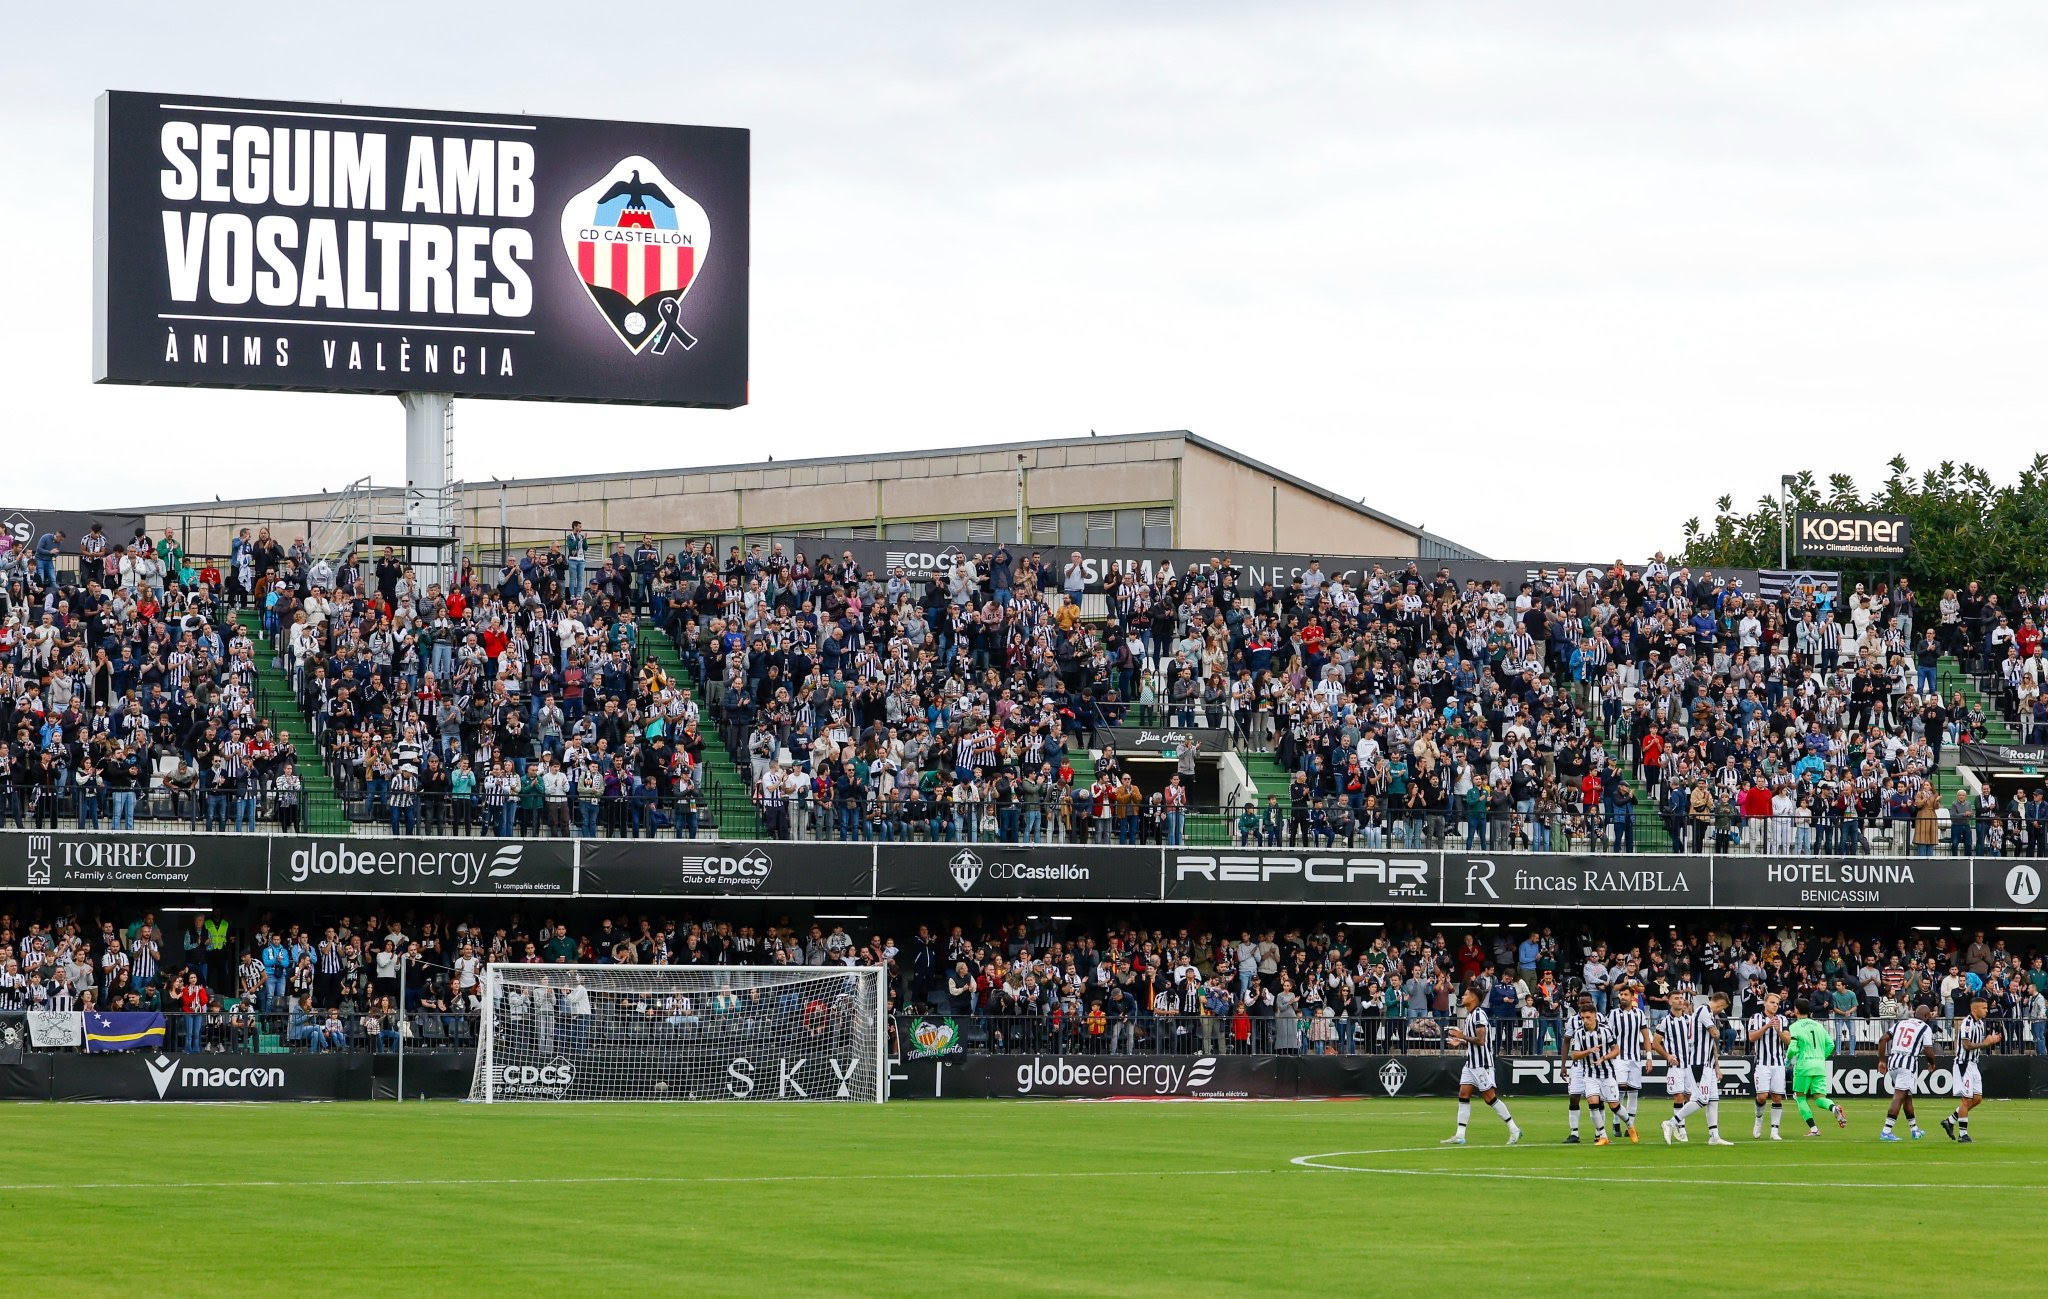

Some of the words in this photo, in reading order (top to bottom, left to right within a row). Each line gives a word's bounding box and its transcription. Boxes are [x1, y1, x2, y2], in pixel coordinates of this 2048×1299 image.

[160, 121, 387, 212] SEGUIM
[401, 136, 534, 217] AMB
[580, 229, 599, 241] CD
[604, 230, 692, 245] CASTELLÓN
[161, 210, 534, 317] VOSALTRES
[165, 327, 289, 367] ÀNIMS
[322, 338, 513, 376] VALÈNCIA
[1826, 543, 1873, 553] Climatización
[1873, 545, 1904, 554] eficiente
[1135, 731, 1161, 745] Blue
[2010, 749, 2045, 760] Rosell
[58, 842, 196, 868] TORRECID
[290, 843, 487, 886] globeenergy
[703, 856, 768, 876] CDCS
[1177, 856, 1428, 884] REPCAR
[1767, 864, 1837, 883] HOTEL
[1840, 865, 1915, 884] SUNNA
[65, 871, 72, 879] A
[74, 871, 105, 882] Family
[106, 872, 113, 880] &
[115, 871, 143, 880] Green
[144, 871, 189, 882] Company
[682, 876, 703, 884] Club
[704, 876, 716, 884] de
[717, 876, 760, 886] Empresas
[1514, 869, 1577, 891] fincas
[1582, 871, 1690, 892] RAMBLA
[494, 882, 502, 890] Tu
[534, 882, 561, 891] eléctrica
[1388, 889, 1428, 897] STILL
[1801, 890, 1880, 902] BENICASSIM
[1810, 1030, 1816, 1049] 1
[1896, 1026, 1915, 1048] 15
[181, 1067, 285, 1088] macron
[503, 1065, 572, 1085] CDCS
[1017, 1057, 1186, 1095] globeenergy
[1667, 1077, 1675, 1086] 23
[1964, 1079, 1970, 1089] 4
[1191, 1090, 1199, 1098] Tu
[1225, 1090, 1249, 1098] eléctrica
[1701, 1086, 1709, 1095] 10
